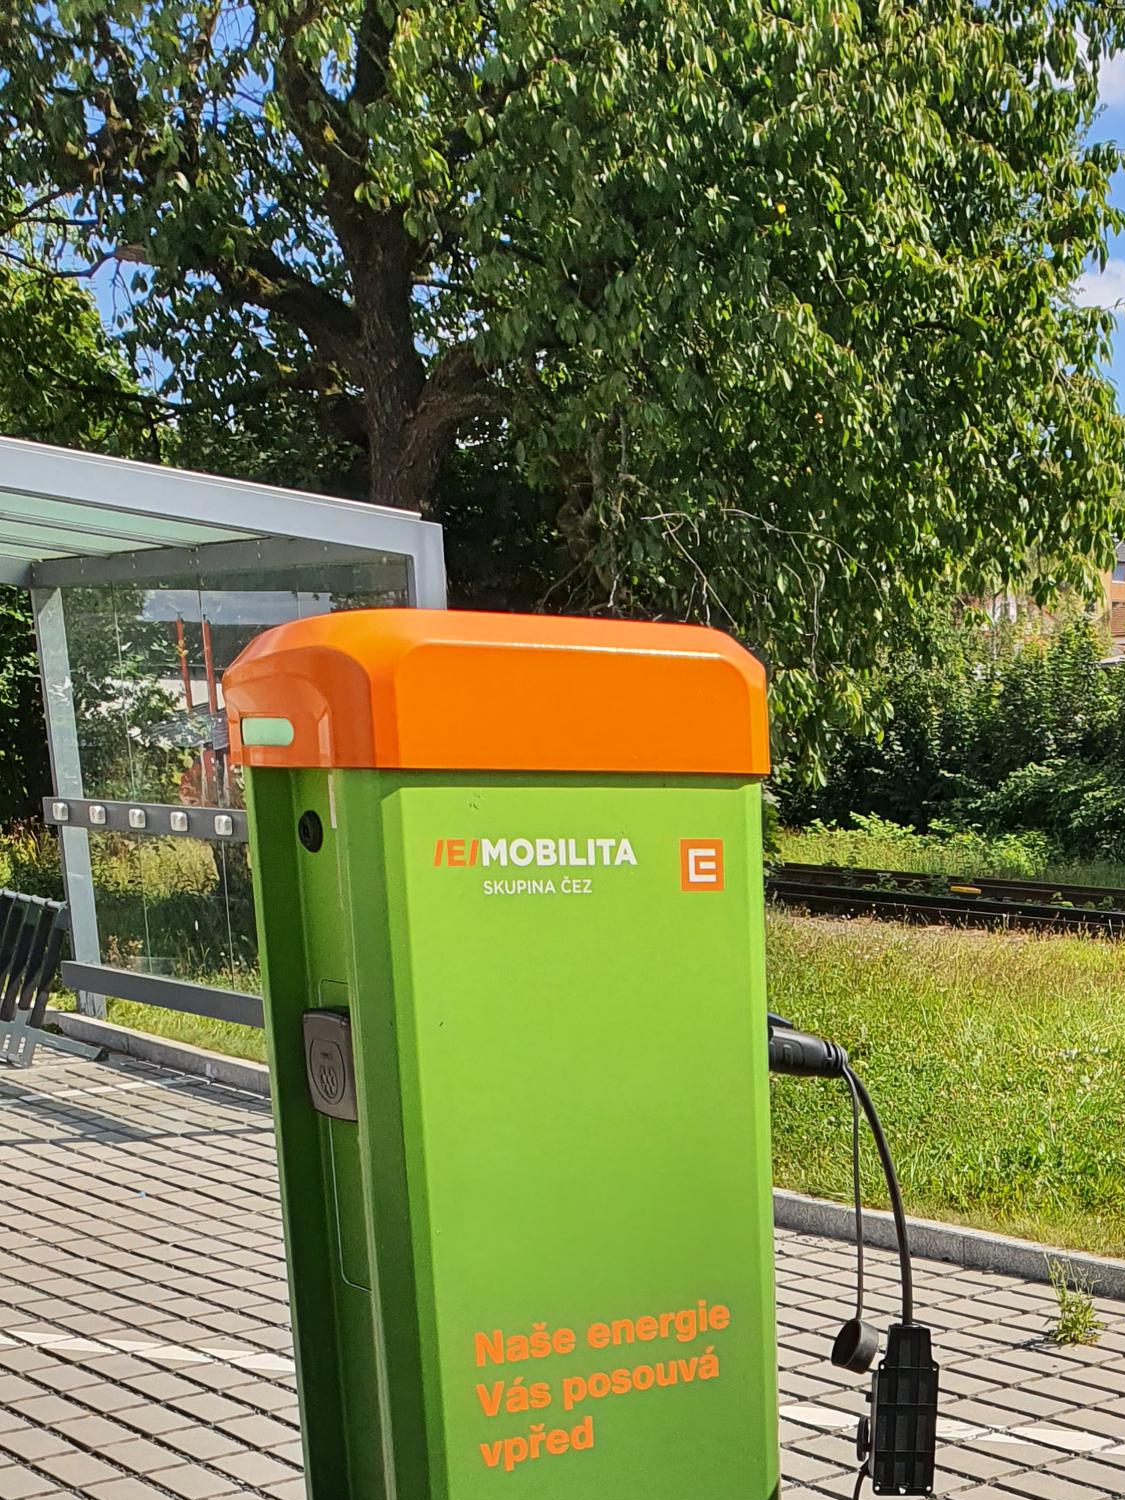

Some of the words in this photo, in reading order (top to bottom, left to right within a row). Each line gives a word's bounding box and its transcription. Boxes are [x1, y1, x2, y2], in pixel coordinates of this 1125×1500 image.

[483, 880, 556, 895] SKUPINA
[561, 876, 592, 894] ČEZ
[474, 1321, 577, 1368] Naše
[587, 1299, 731, 1348] energie
[476, 1376, 552, 1417] Vás
[562, 1345, 720, 1411] posouvá
[480, 1416, 594, 1472] vpřed
